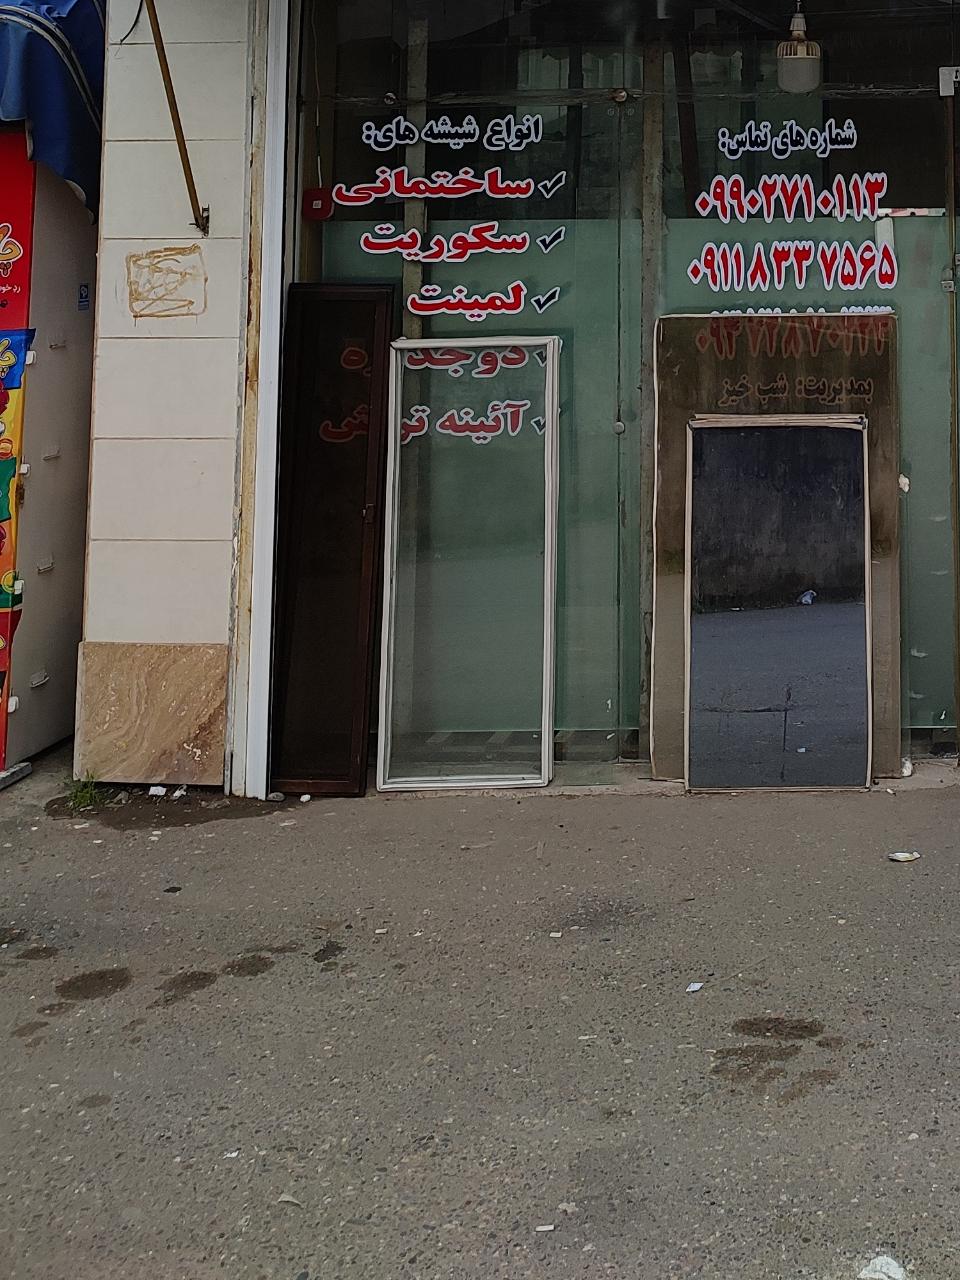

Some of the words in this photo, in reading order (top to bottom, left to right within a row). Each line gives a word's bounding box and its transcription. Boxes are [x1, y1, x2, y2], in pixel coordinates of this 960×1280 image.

[421, 114, 480, 149] شیشه
[483, 114, 543, 151] انواع
[772, 119, 807, 160] های
[807, 117, 858, 158] شماره
[332, 166, 535, 206] ساختمانی
[695, 172, 888, 224] ۰۹۹۰۲۷۱۰۱۱۳
[360, 221, 530, 262] سکوریت
[407, 280, 528, 322] لمینت
[755, 372, 789, 404] شب
